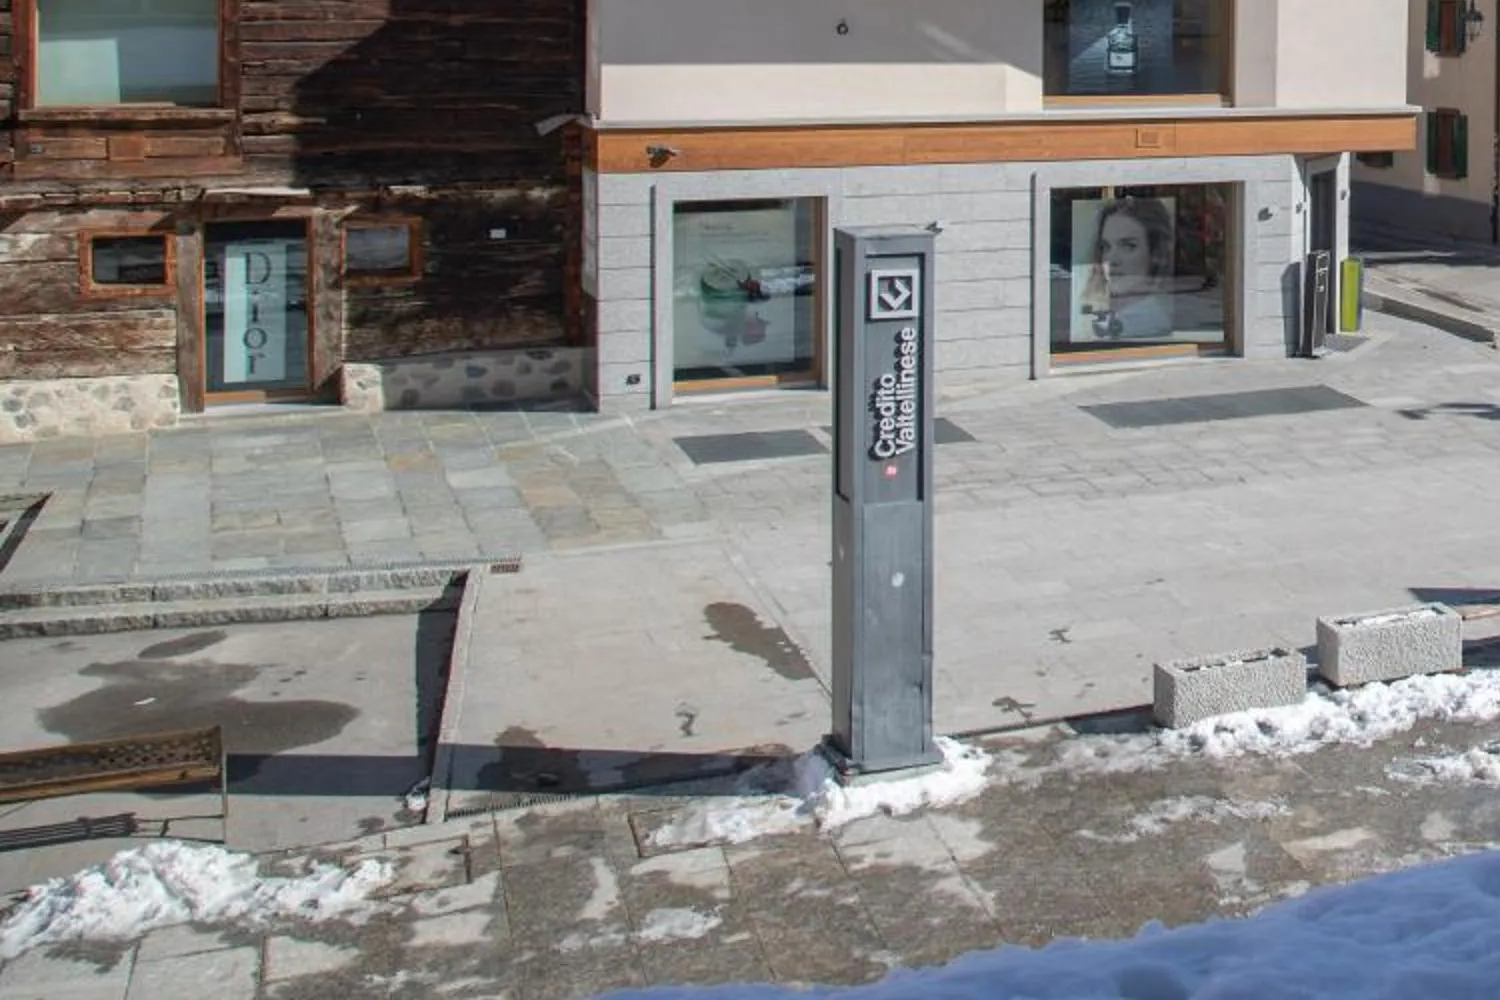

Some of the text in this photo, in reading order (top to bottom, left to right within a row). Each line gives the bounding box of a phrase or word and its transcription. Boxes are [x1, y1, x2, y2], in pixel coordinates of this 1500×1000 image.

[244, 252, 272, 375] Dior
[874, 327, 917, 457] Credito Valtellinese
